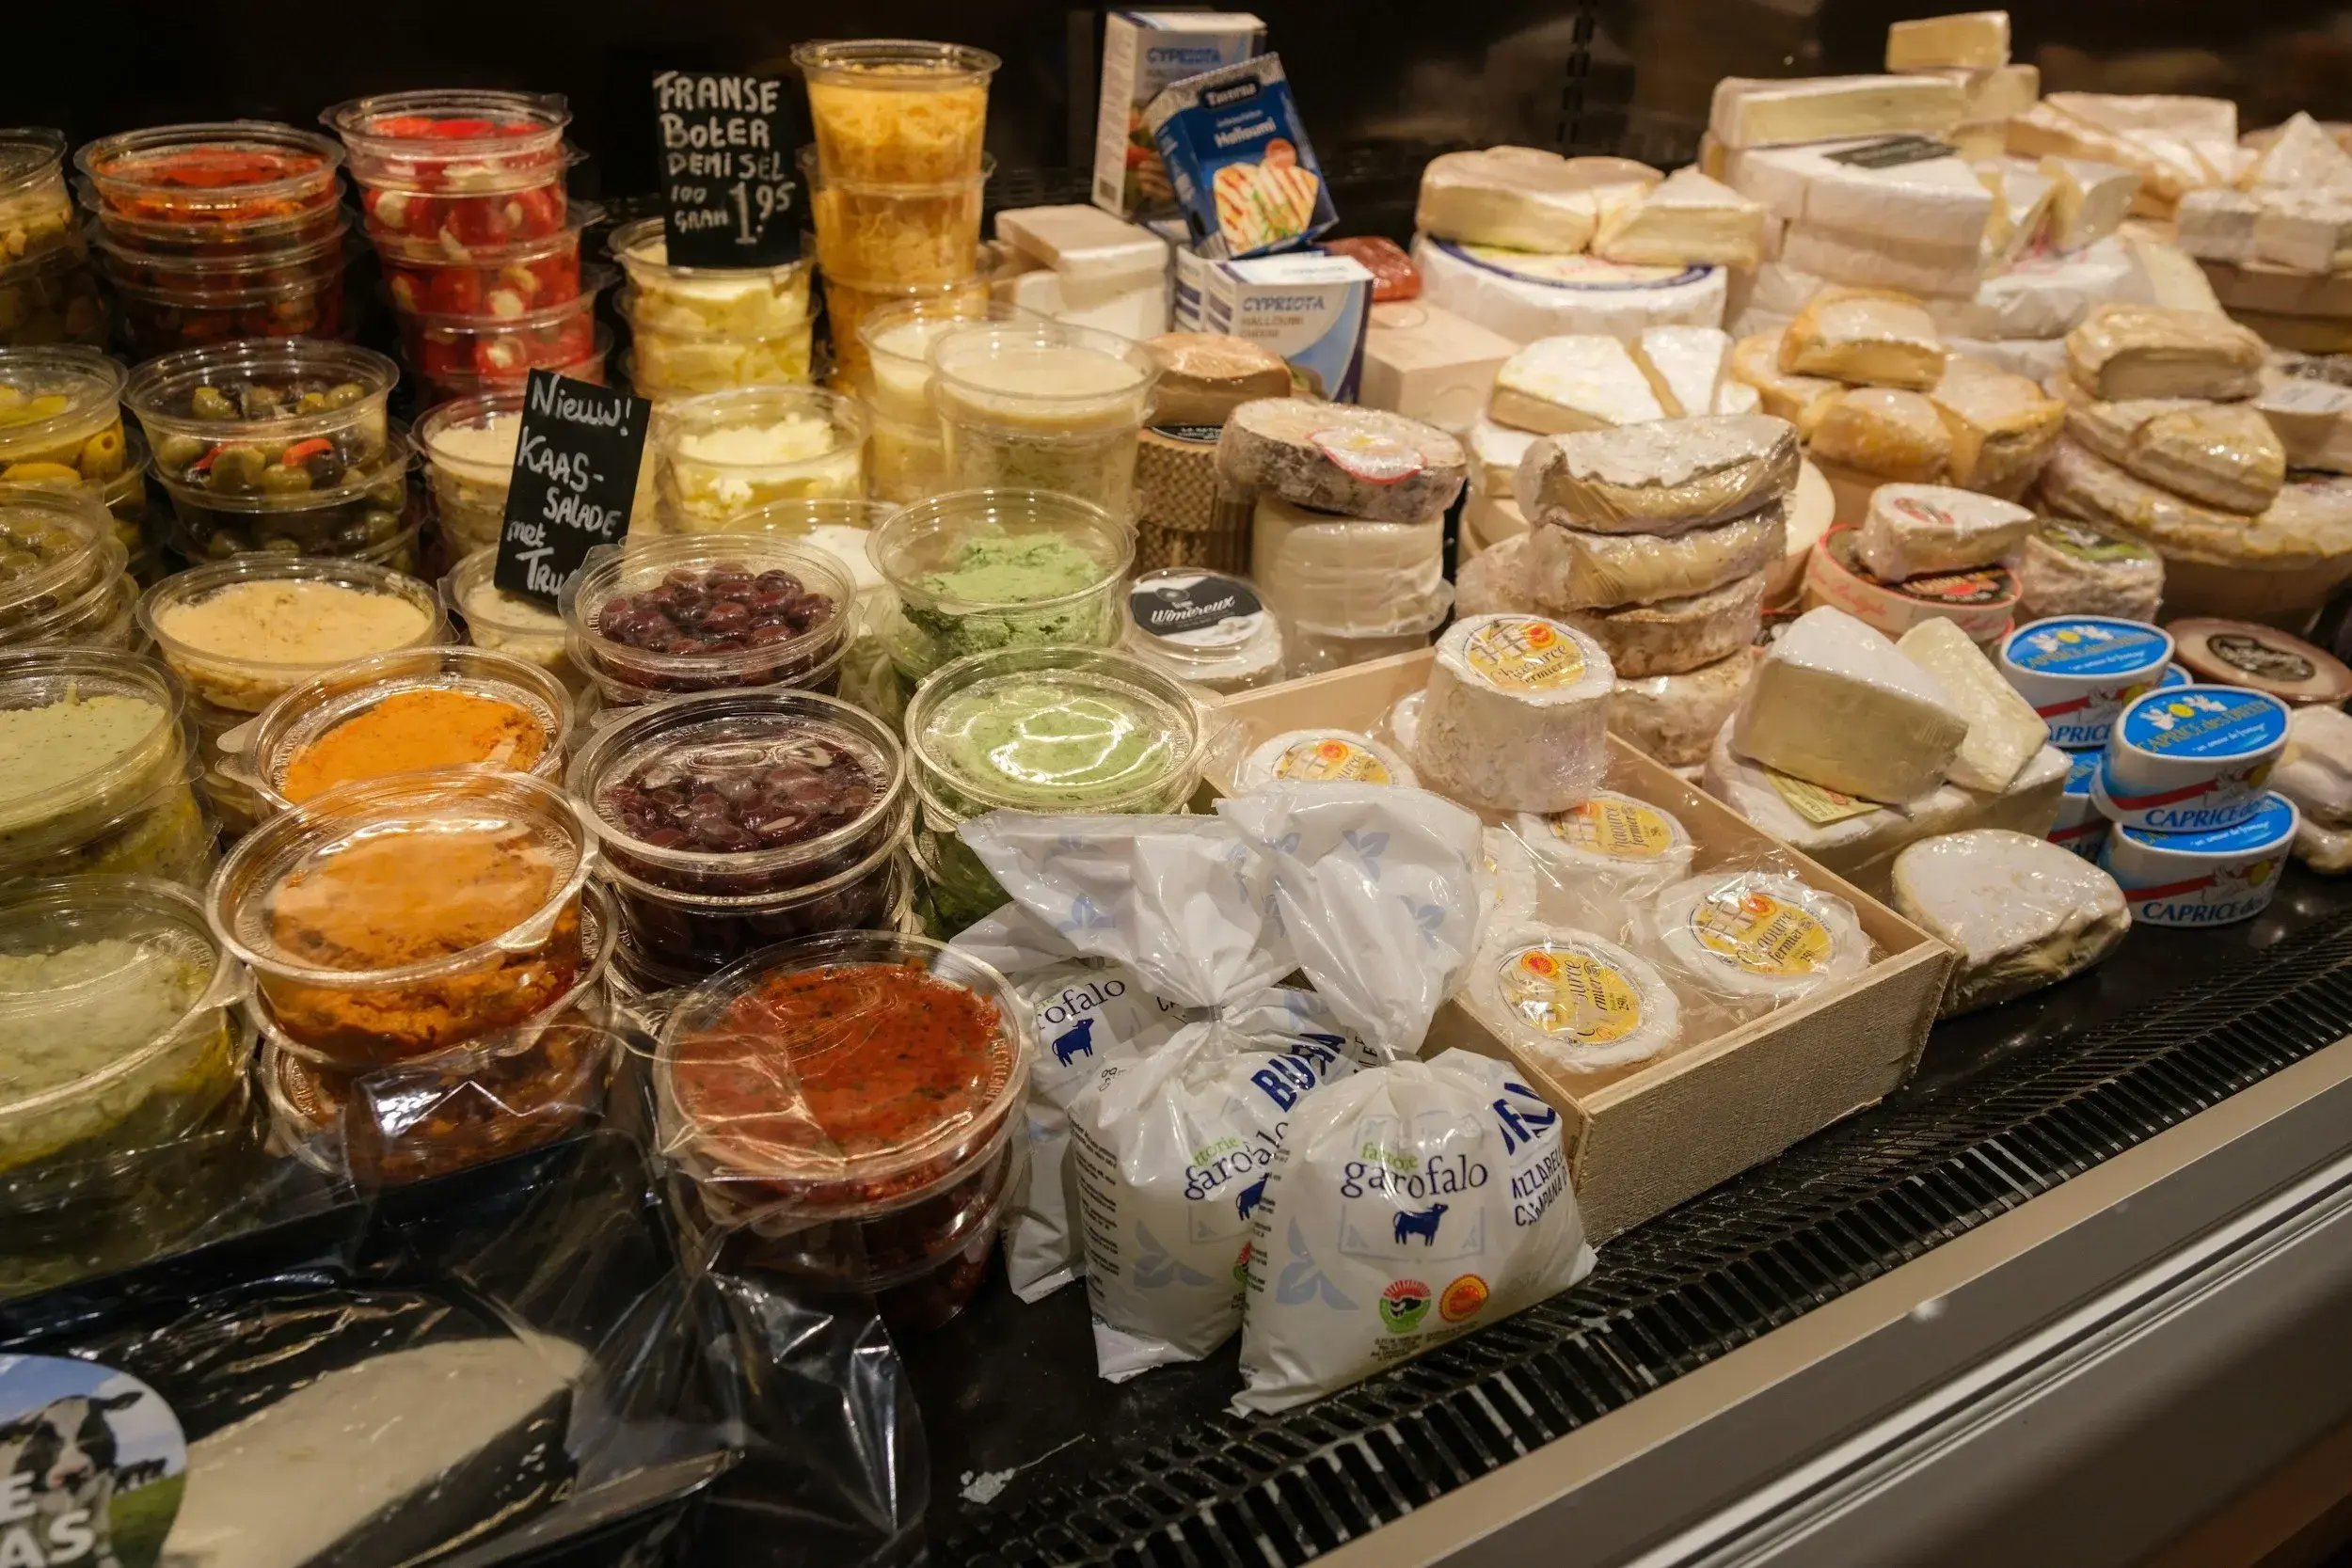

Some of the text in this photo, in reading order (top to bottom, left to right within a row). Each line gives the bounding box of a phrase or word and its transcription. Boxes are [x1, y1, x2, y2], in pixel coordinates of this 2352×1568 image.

[653, 71, 782, 115] FRANSE
[738, 150, 785, 181] SEL
[671, 184, 707, 204] 100
[674, 210, 729, 234] GRAM
[531, 374, 633, 437] Nieuw!
[517, 425, 604, 493] KAAS-
[542, 485, 622, 537] SALADE
[506, 521, 548, 547] met
[1151, 594, 1237, 625] Wimereux
[2145, 806, 2237, 828] CAPRICE
[2141, 903, 2237, 923] CAPRICE
[1341, 1153, 1489, 1199] garofalo
